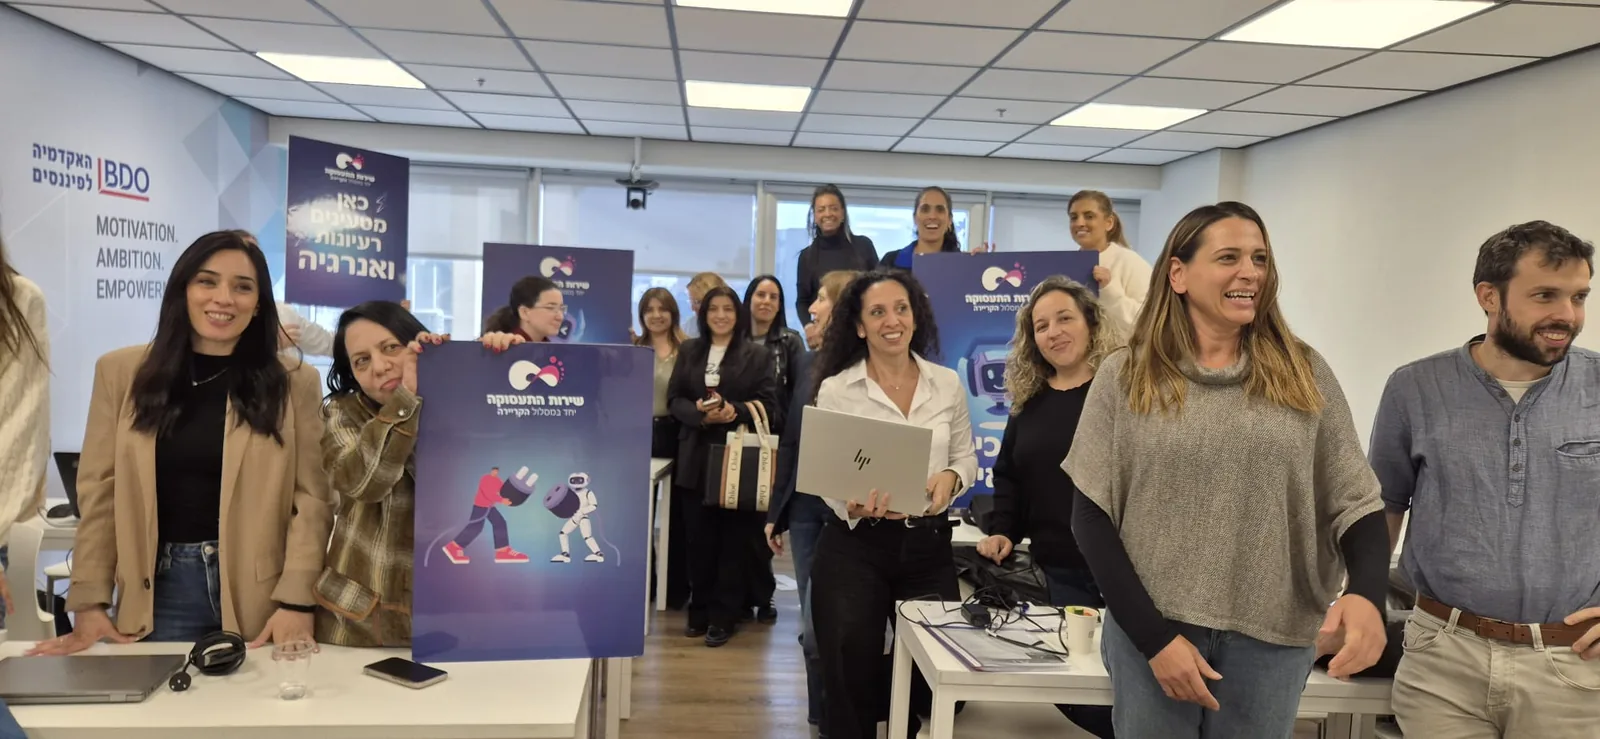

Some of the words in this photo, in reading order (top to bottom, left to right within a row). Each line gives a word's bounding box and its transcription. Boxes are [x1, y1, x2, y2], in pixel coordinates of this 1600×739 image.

[32, 142, 93, 170] האקדמיה
[32, 167, 93, 192] לפיננסים
[104, 159, 150, 194] BDO
[337, 192, 369, 212] כאן
[96, 214, 179, 243] MOTIVATION.
[314, 230, 382, 252] רעיונות
[96, 247, 164, 271] AMBITION.
[298, 249, 396, 281] ואנרגיה
[965, 294, 1011, 306] התעסוקה
[973, 305, 999, 313] הקריירה
[486, 394, 545, 408] התעסוקה
[548, 396, 585, 407] שירות
[497, 408, 531, 418] הקריירה
[532, 407, 562, 417] במסלול
[563, 408, 577, 417] יחד
[854, 448, 871, 471] hp
